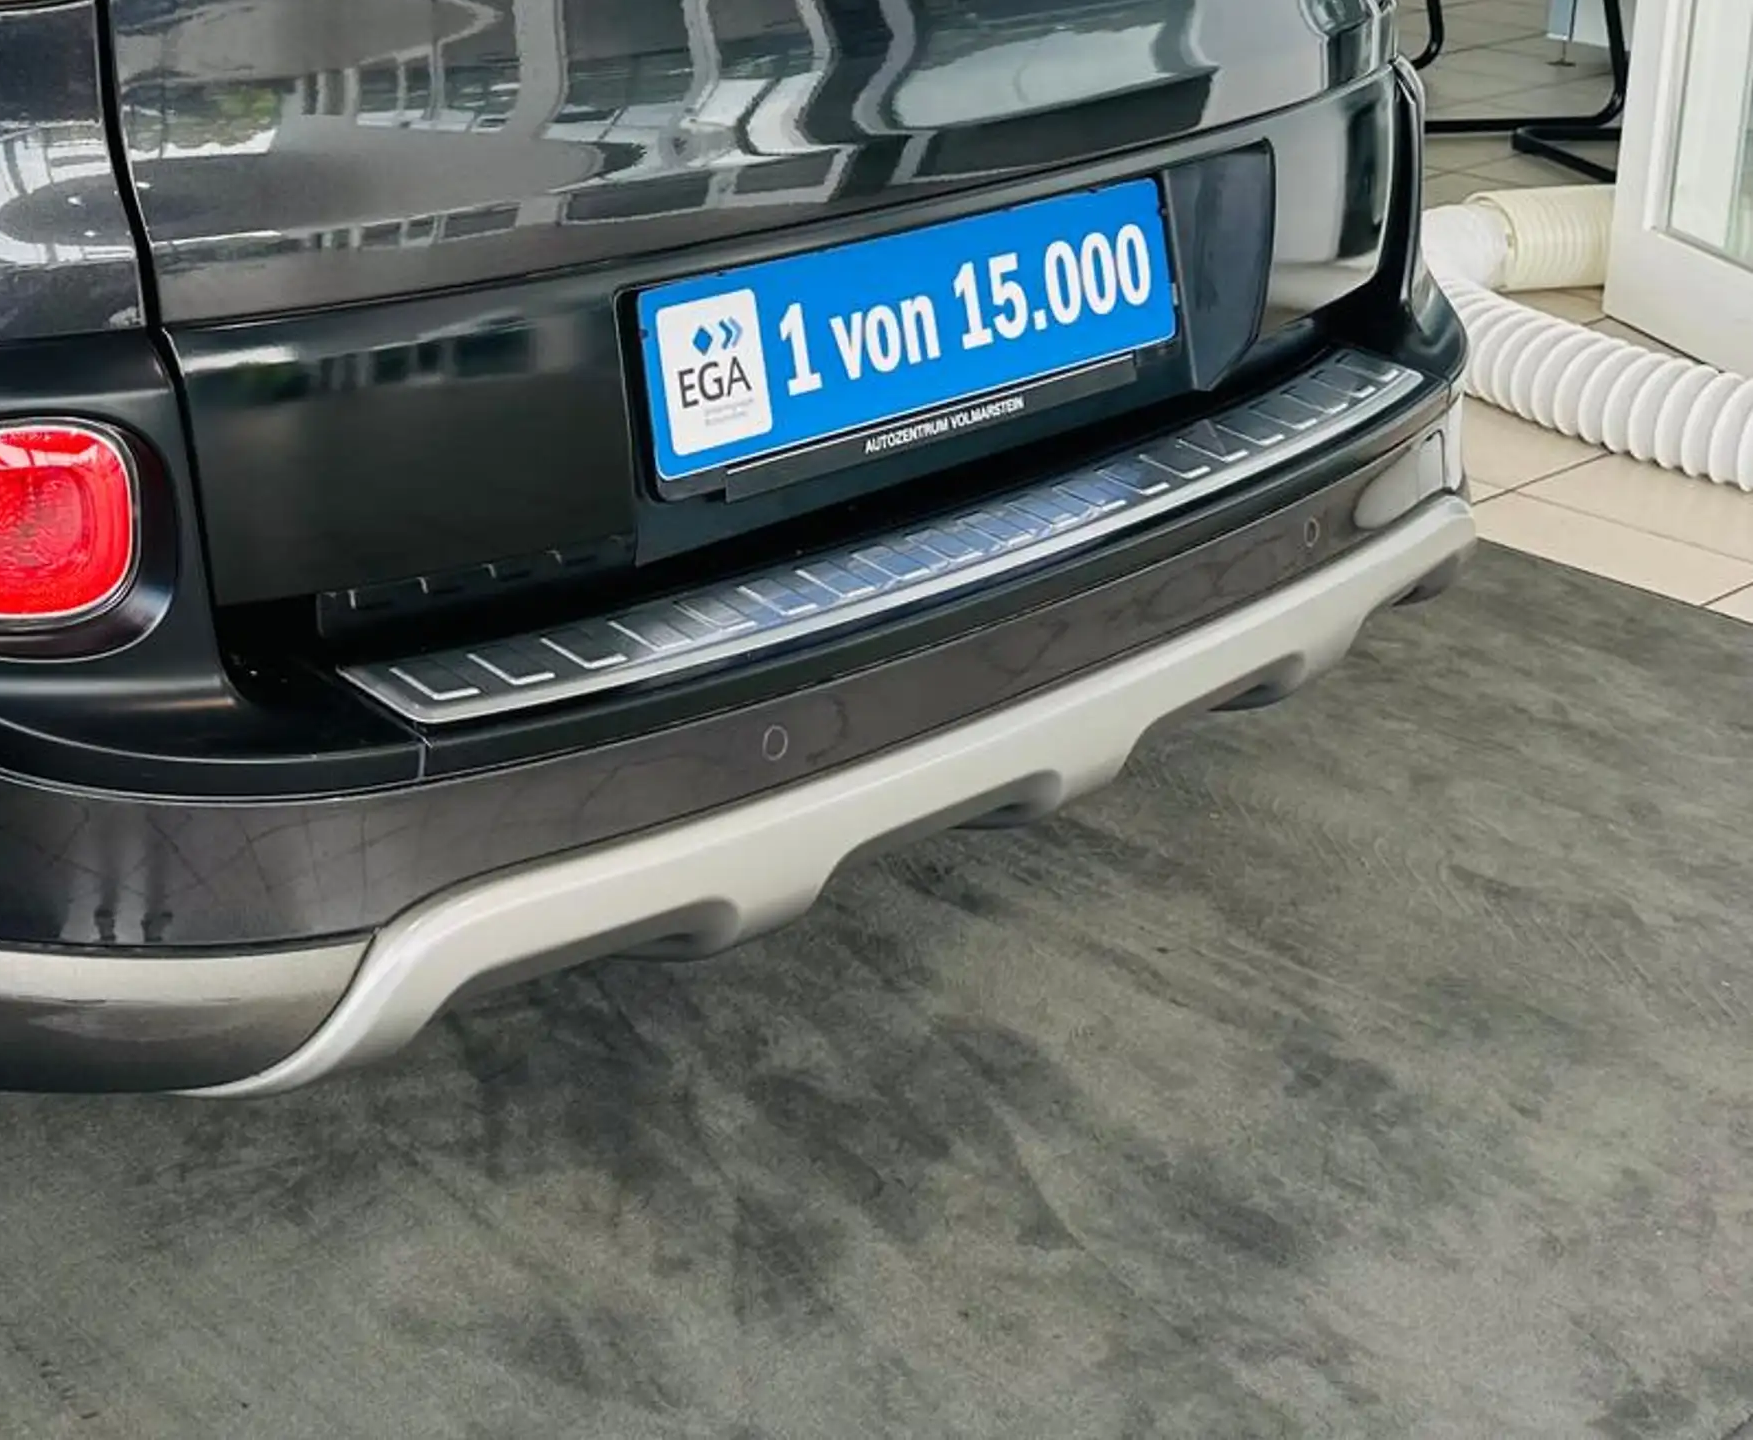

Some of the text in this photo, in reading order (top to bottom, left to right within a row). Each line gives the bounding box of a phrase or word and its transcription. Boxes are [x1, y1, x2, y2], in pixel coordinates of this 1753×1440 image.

[779, 223, 1151, 396] 1 von 15.000
[677, 355, 752, 409] EGA
[864, 395, 1025, 454] AUTOZENTRUM VOLMARSTEIN
